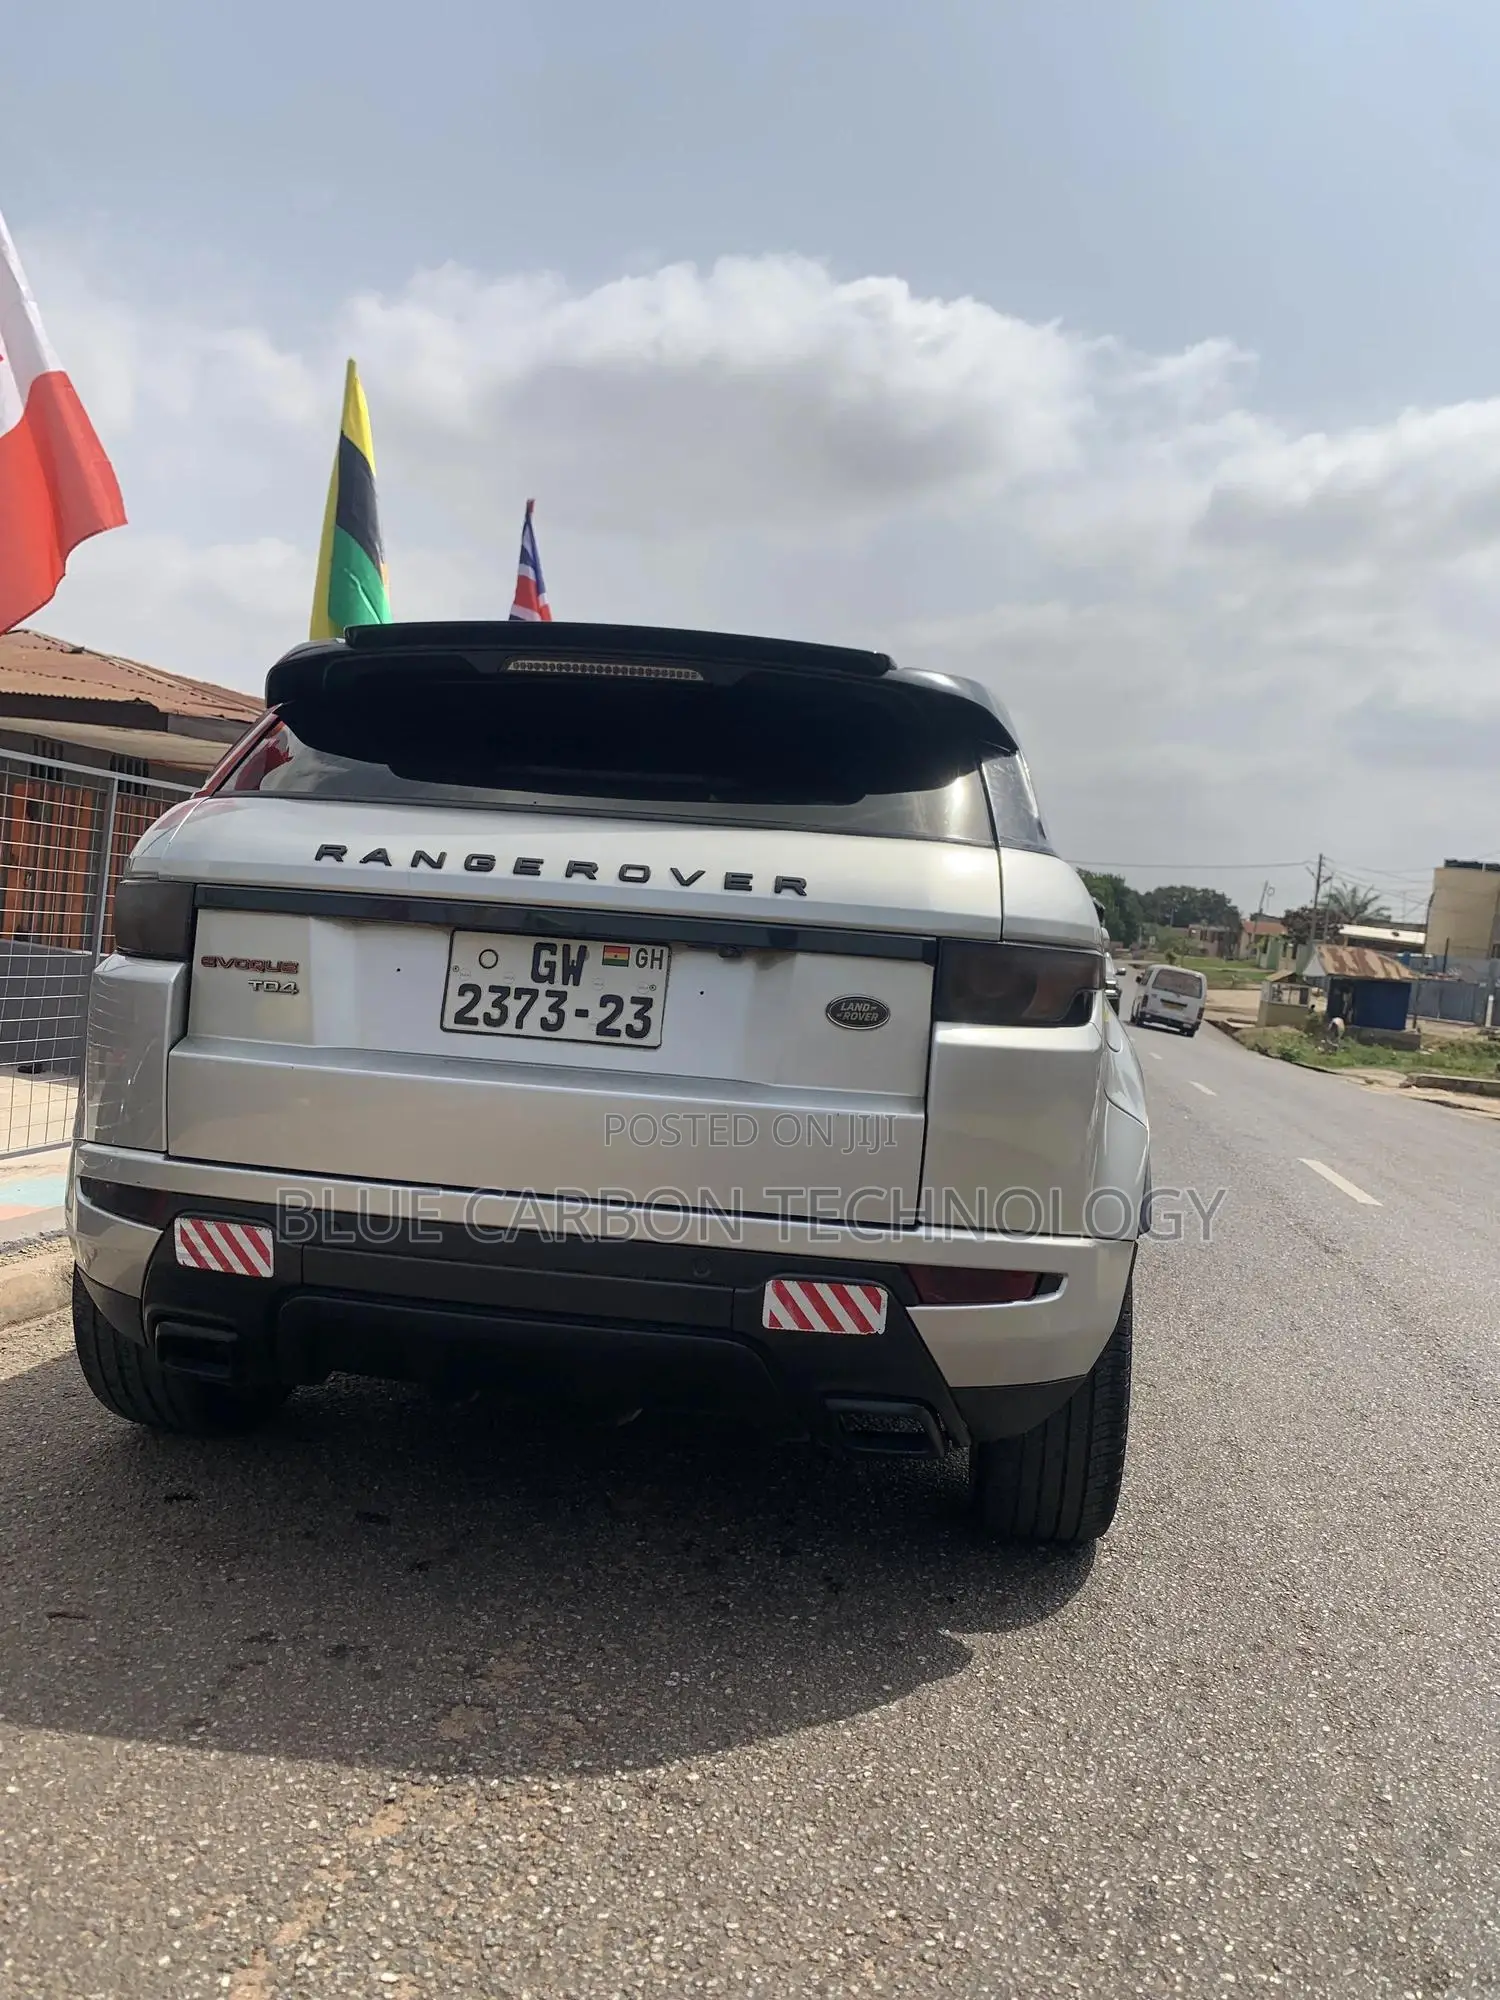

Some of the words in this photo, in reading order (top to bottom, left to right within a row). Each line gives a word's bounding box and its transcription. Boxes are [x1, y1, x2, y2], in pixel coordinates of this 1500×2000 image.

[530, 941, 588, 987] GW
[635, 947, 664, 970] GH
[247, 979, 299, 995] TD4
[453, 983, 654, 1039] 2373-23
[841, 1011, 879, 1021] ROVER
